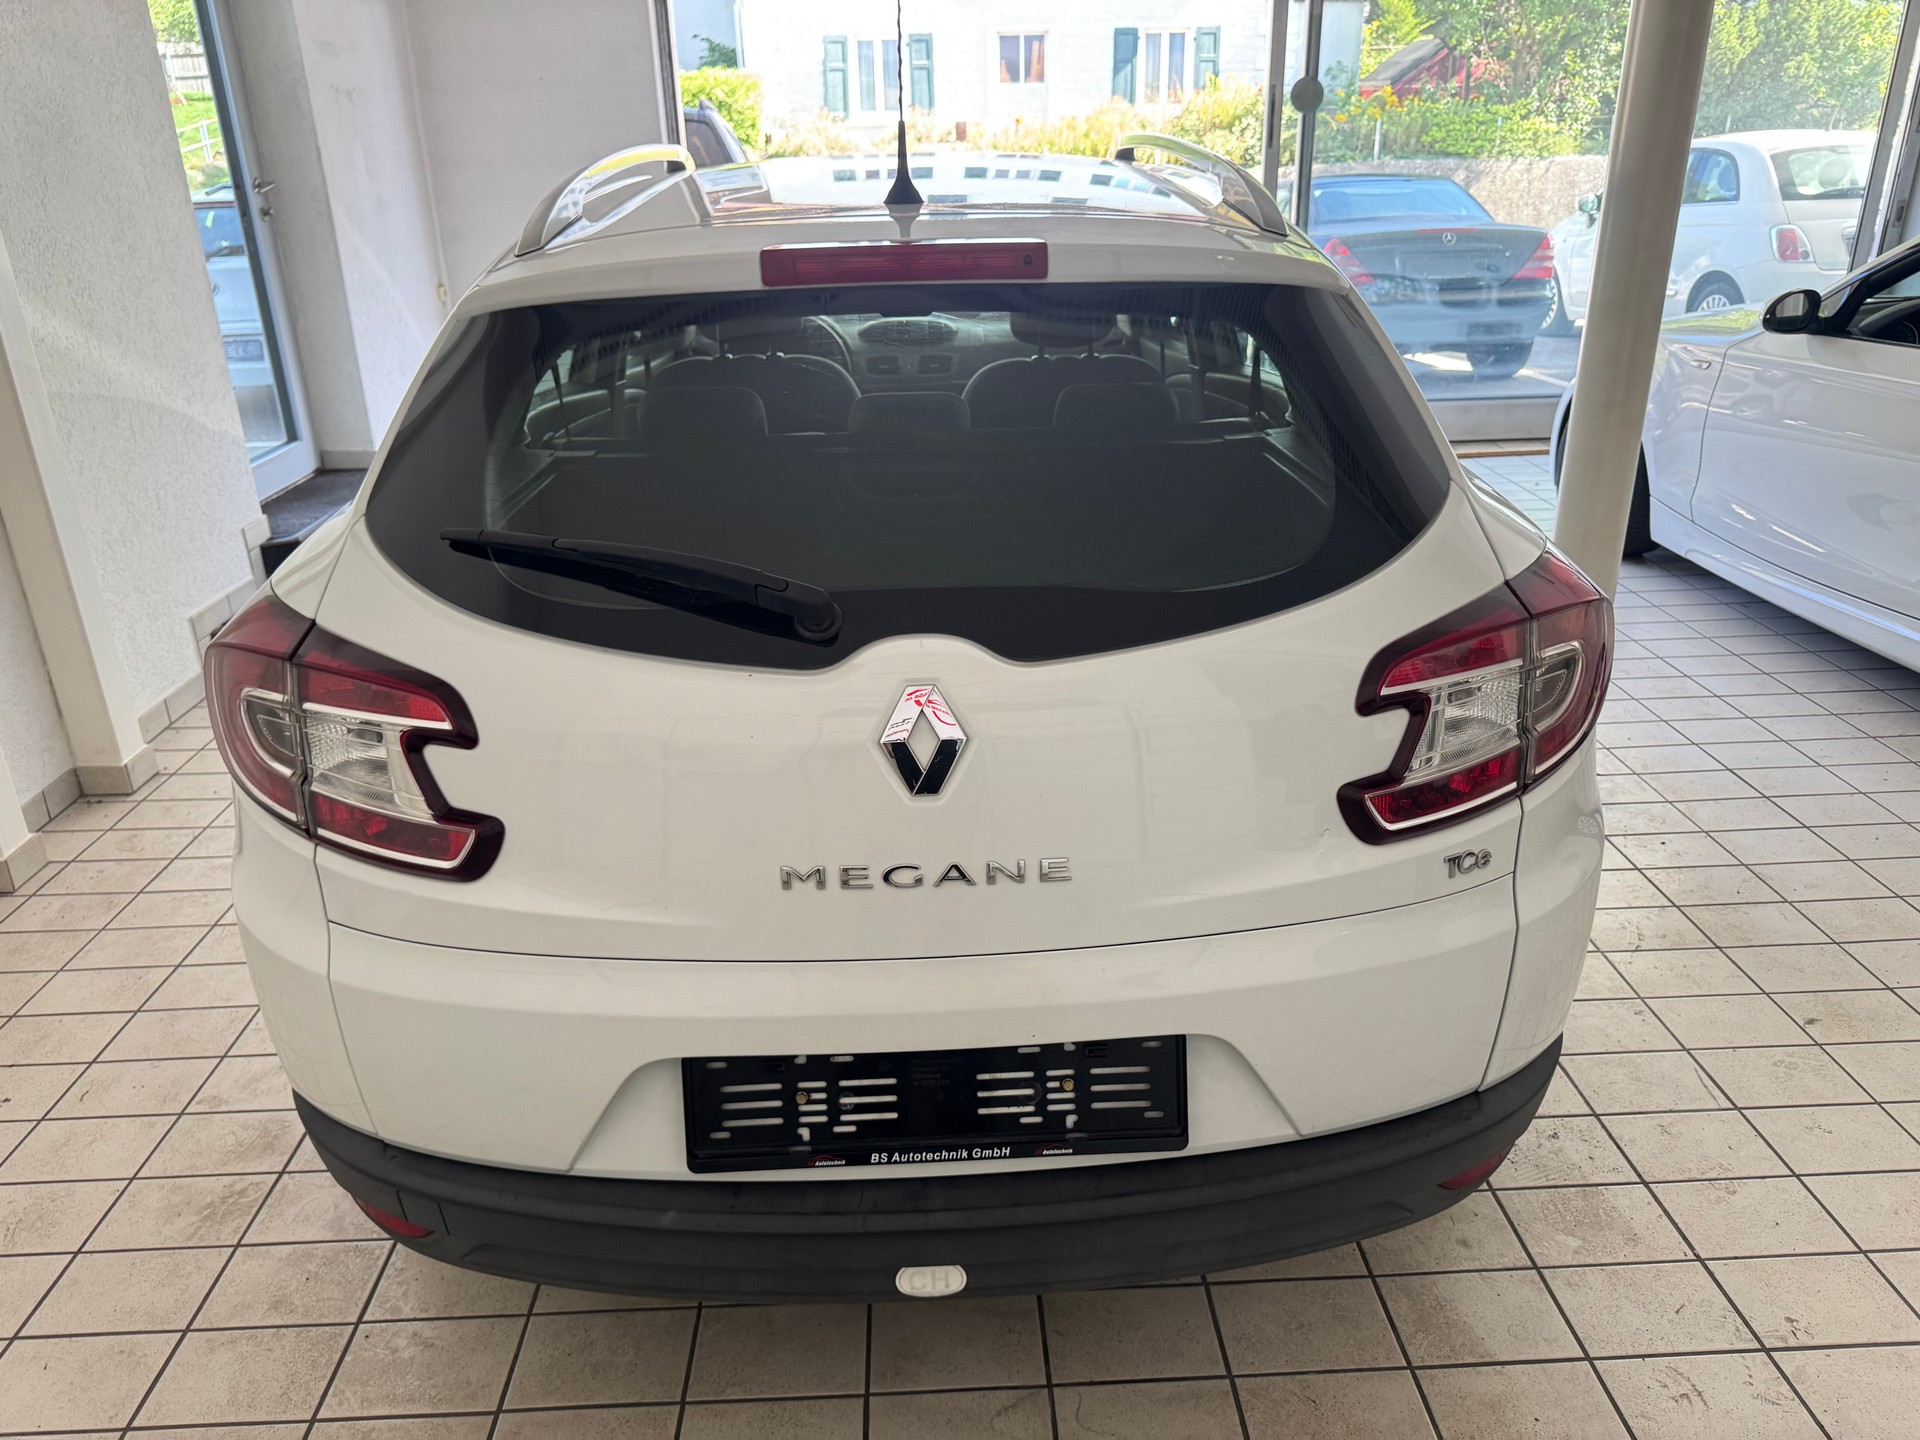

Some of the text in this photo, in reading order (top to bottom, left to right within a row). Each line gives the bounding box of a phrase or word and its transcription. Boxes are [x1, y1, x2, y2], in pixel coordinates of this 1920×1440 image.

[780, 857, 1072, 890] MEGANE
[870, 1146, 1010, 1163] BS Autotechnik GmbH
[908, 1269, 950, 1290] CH
